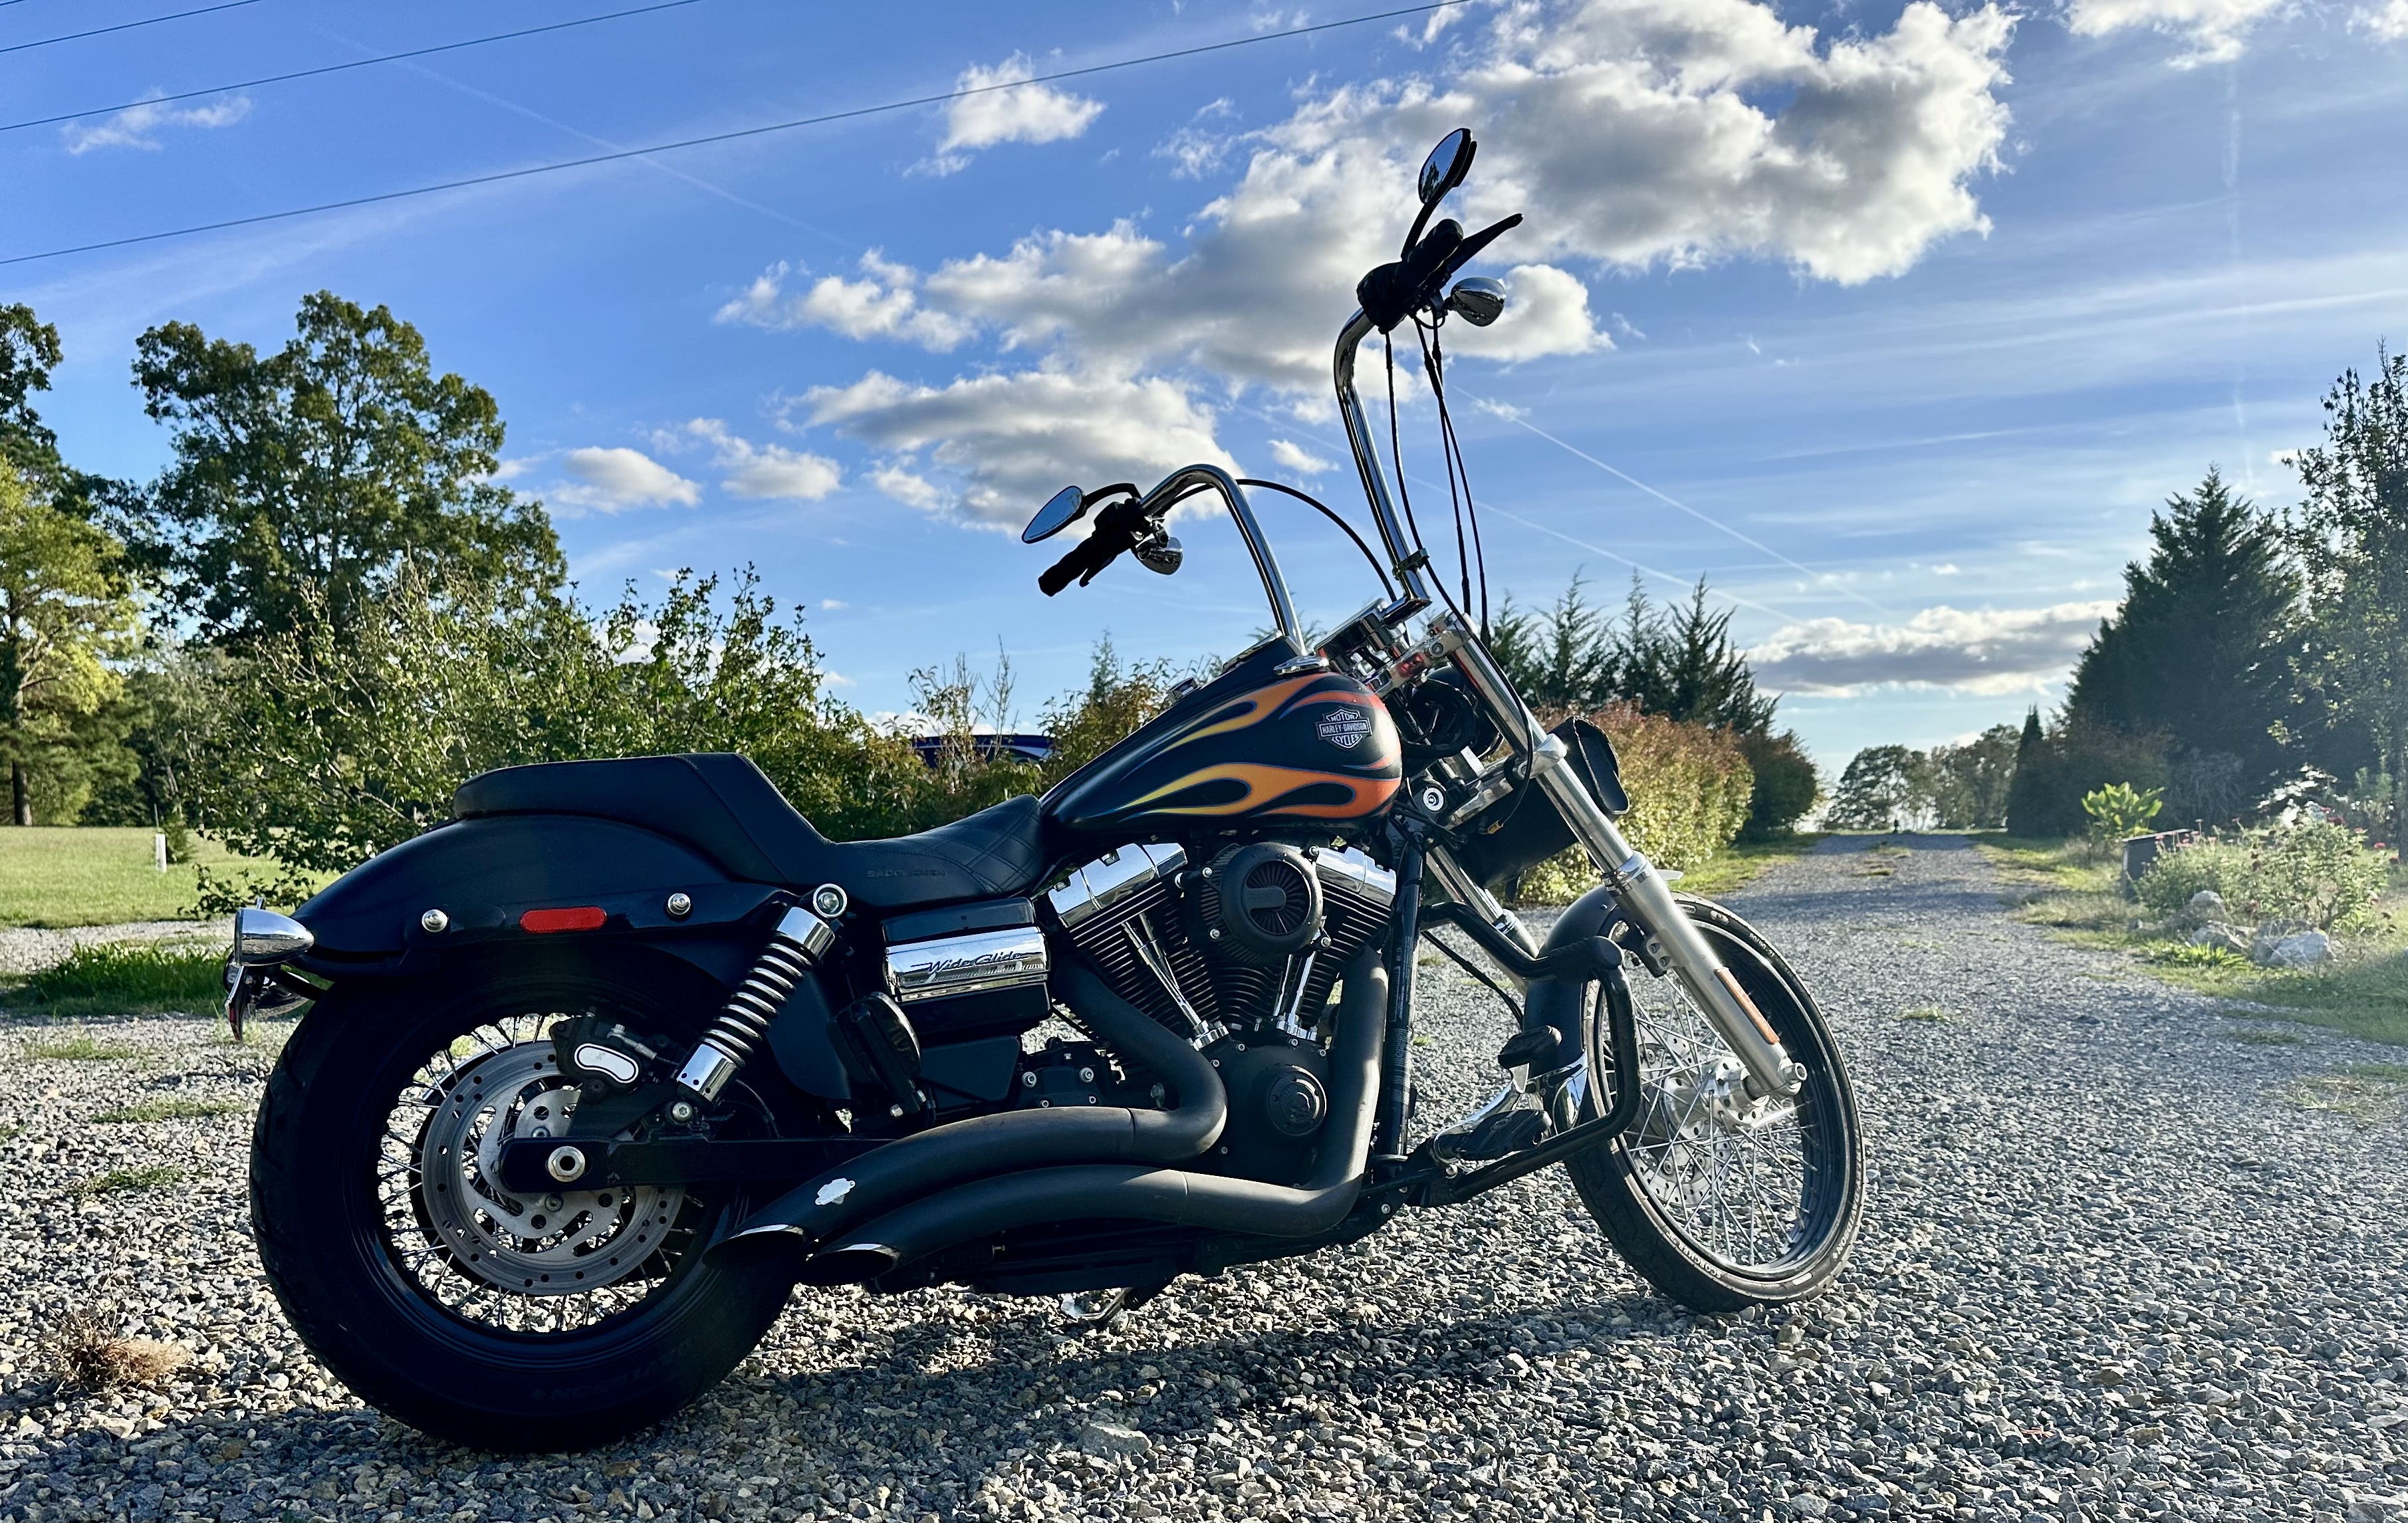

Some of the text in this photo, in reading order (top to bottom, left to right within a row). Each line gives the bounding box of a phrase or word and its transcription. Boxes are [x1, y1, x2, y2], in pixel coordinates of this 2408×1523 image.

[1330, 711, 1356, 722] MOTOR
[1322, 722, 1368, 735] HARLEY-DAVIDSON
[1334, 734, 1360, 746] CYCLES
[913, 951, 1028, 975] Wide Glide
[1677, 1240, 1722, 1279] SCORCHER
